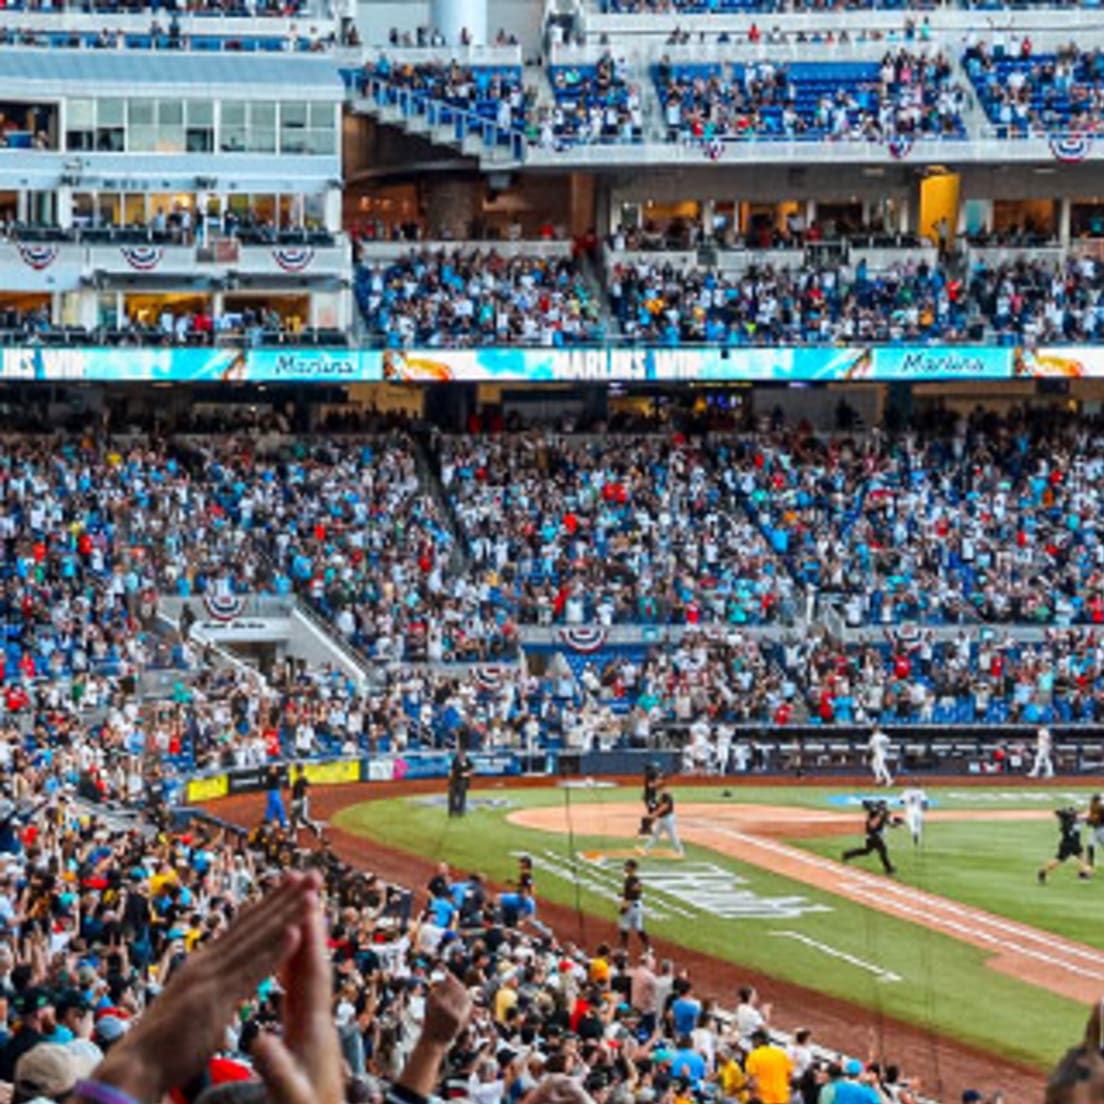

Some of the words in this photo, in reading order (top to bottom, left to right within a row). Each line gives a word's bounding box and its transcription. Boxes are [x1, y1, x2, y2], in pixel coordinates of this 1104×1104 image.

[275, 353, 354, 375] Marlins
[553, 348, 646, 379] MARLINS
[902, 352, 984, 373] Marlins
